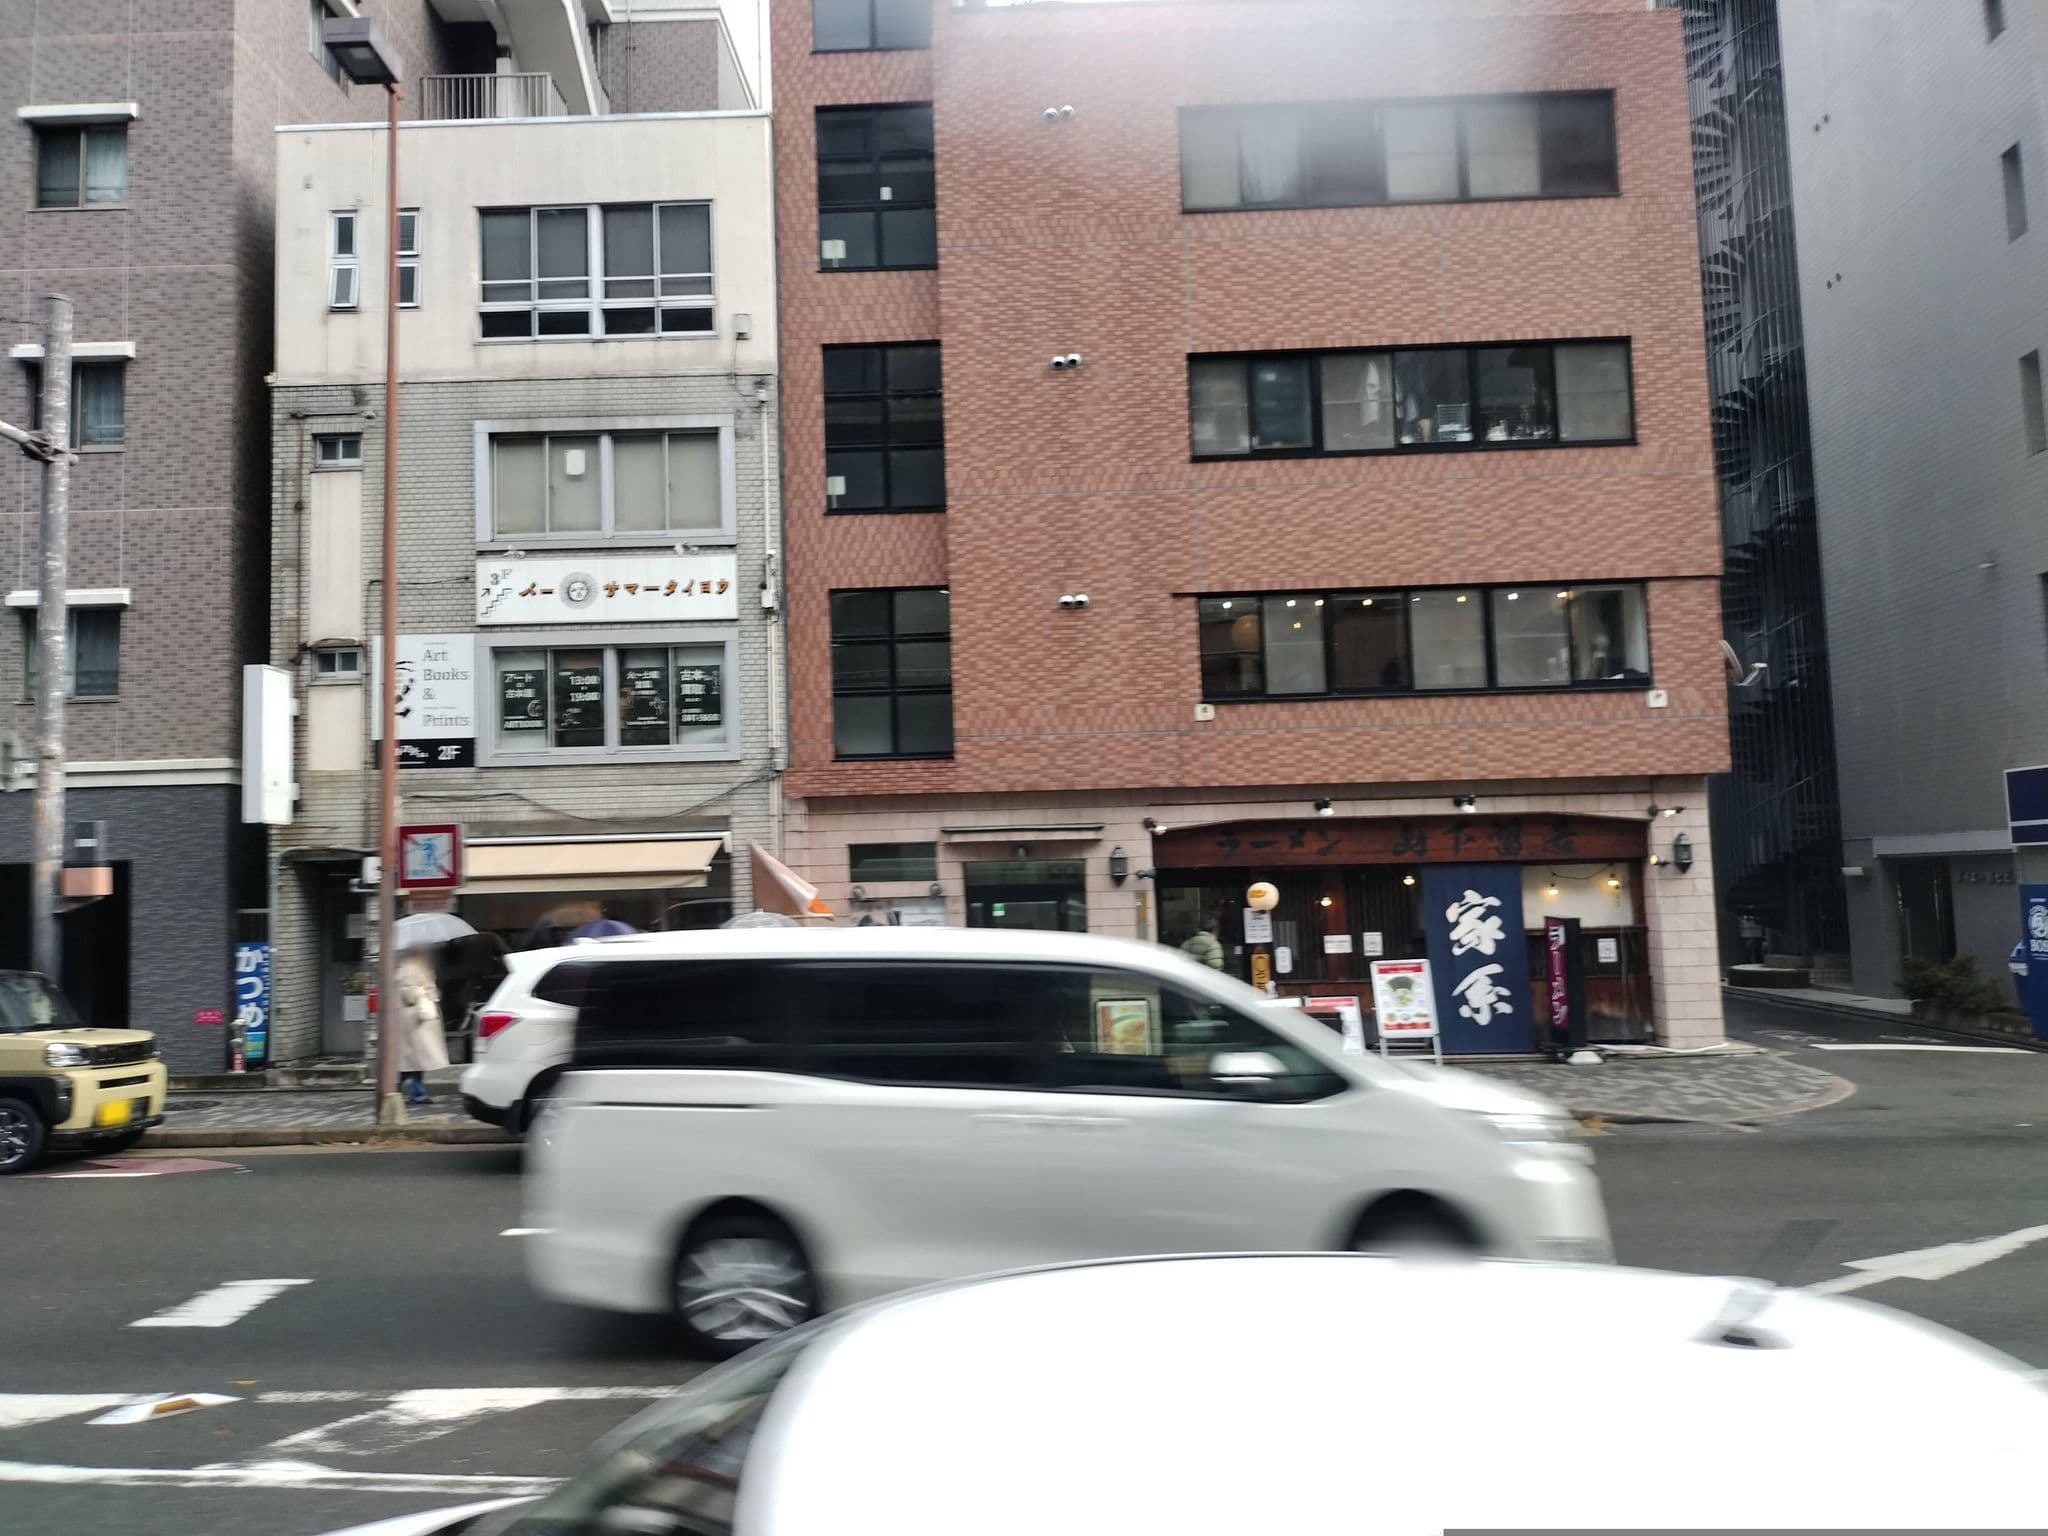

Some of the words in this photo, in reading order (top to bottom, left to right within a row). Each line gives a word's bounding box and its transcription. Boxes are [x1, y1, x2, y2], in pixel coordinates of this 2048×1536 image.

[490, 568, 512, 586] 3F
[422, 649, 448, 662] Art
[423, 667, 470, 681] Books
[422, 687, 437, 700] &
[423, 714, 471, 727] Prints
[437, 745, 462, 760] 2F
[1445, 889, 1514, 1026] 家系
